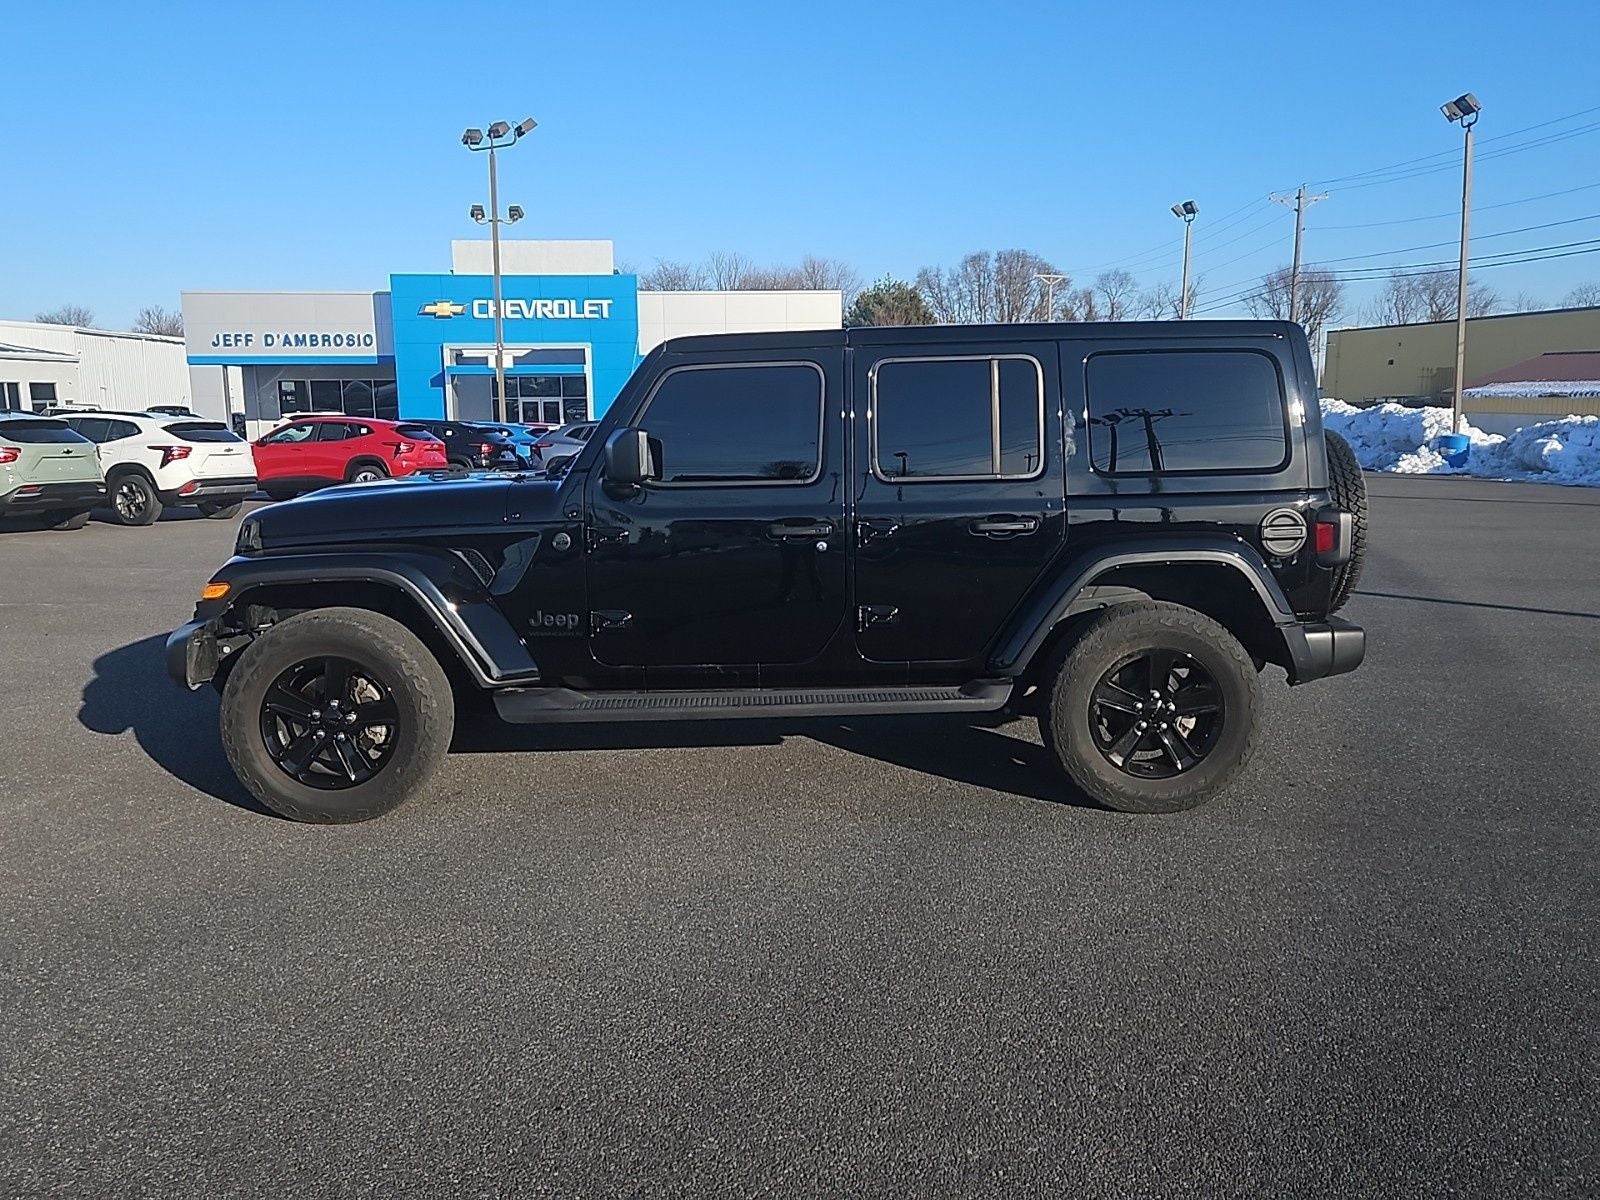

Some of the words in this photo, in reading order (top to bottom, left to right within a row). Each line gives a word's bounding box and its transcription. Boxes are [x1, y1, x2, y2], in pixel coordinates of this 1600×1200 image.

[472, 299, 613, 319] CHEVROLET
[211, 333, 253, 347] JEFF
[264, 333, 373, 347] D'AMBROSIO
[528, 610, 579, 629] Jeep
